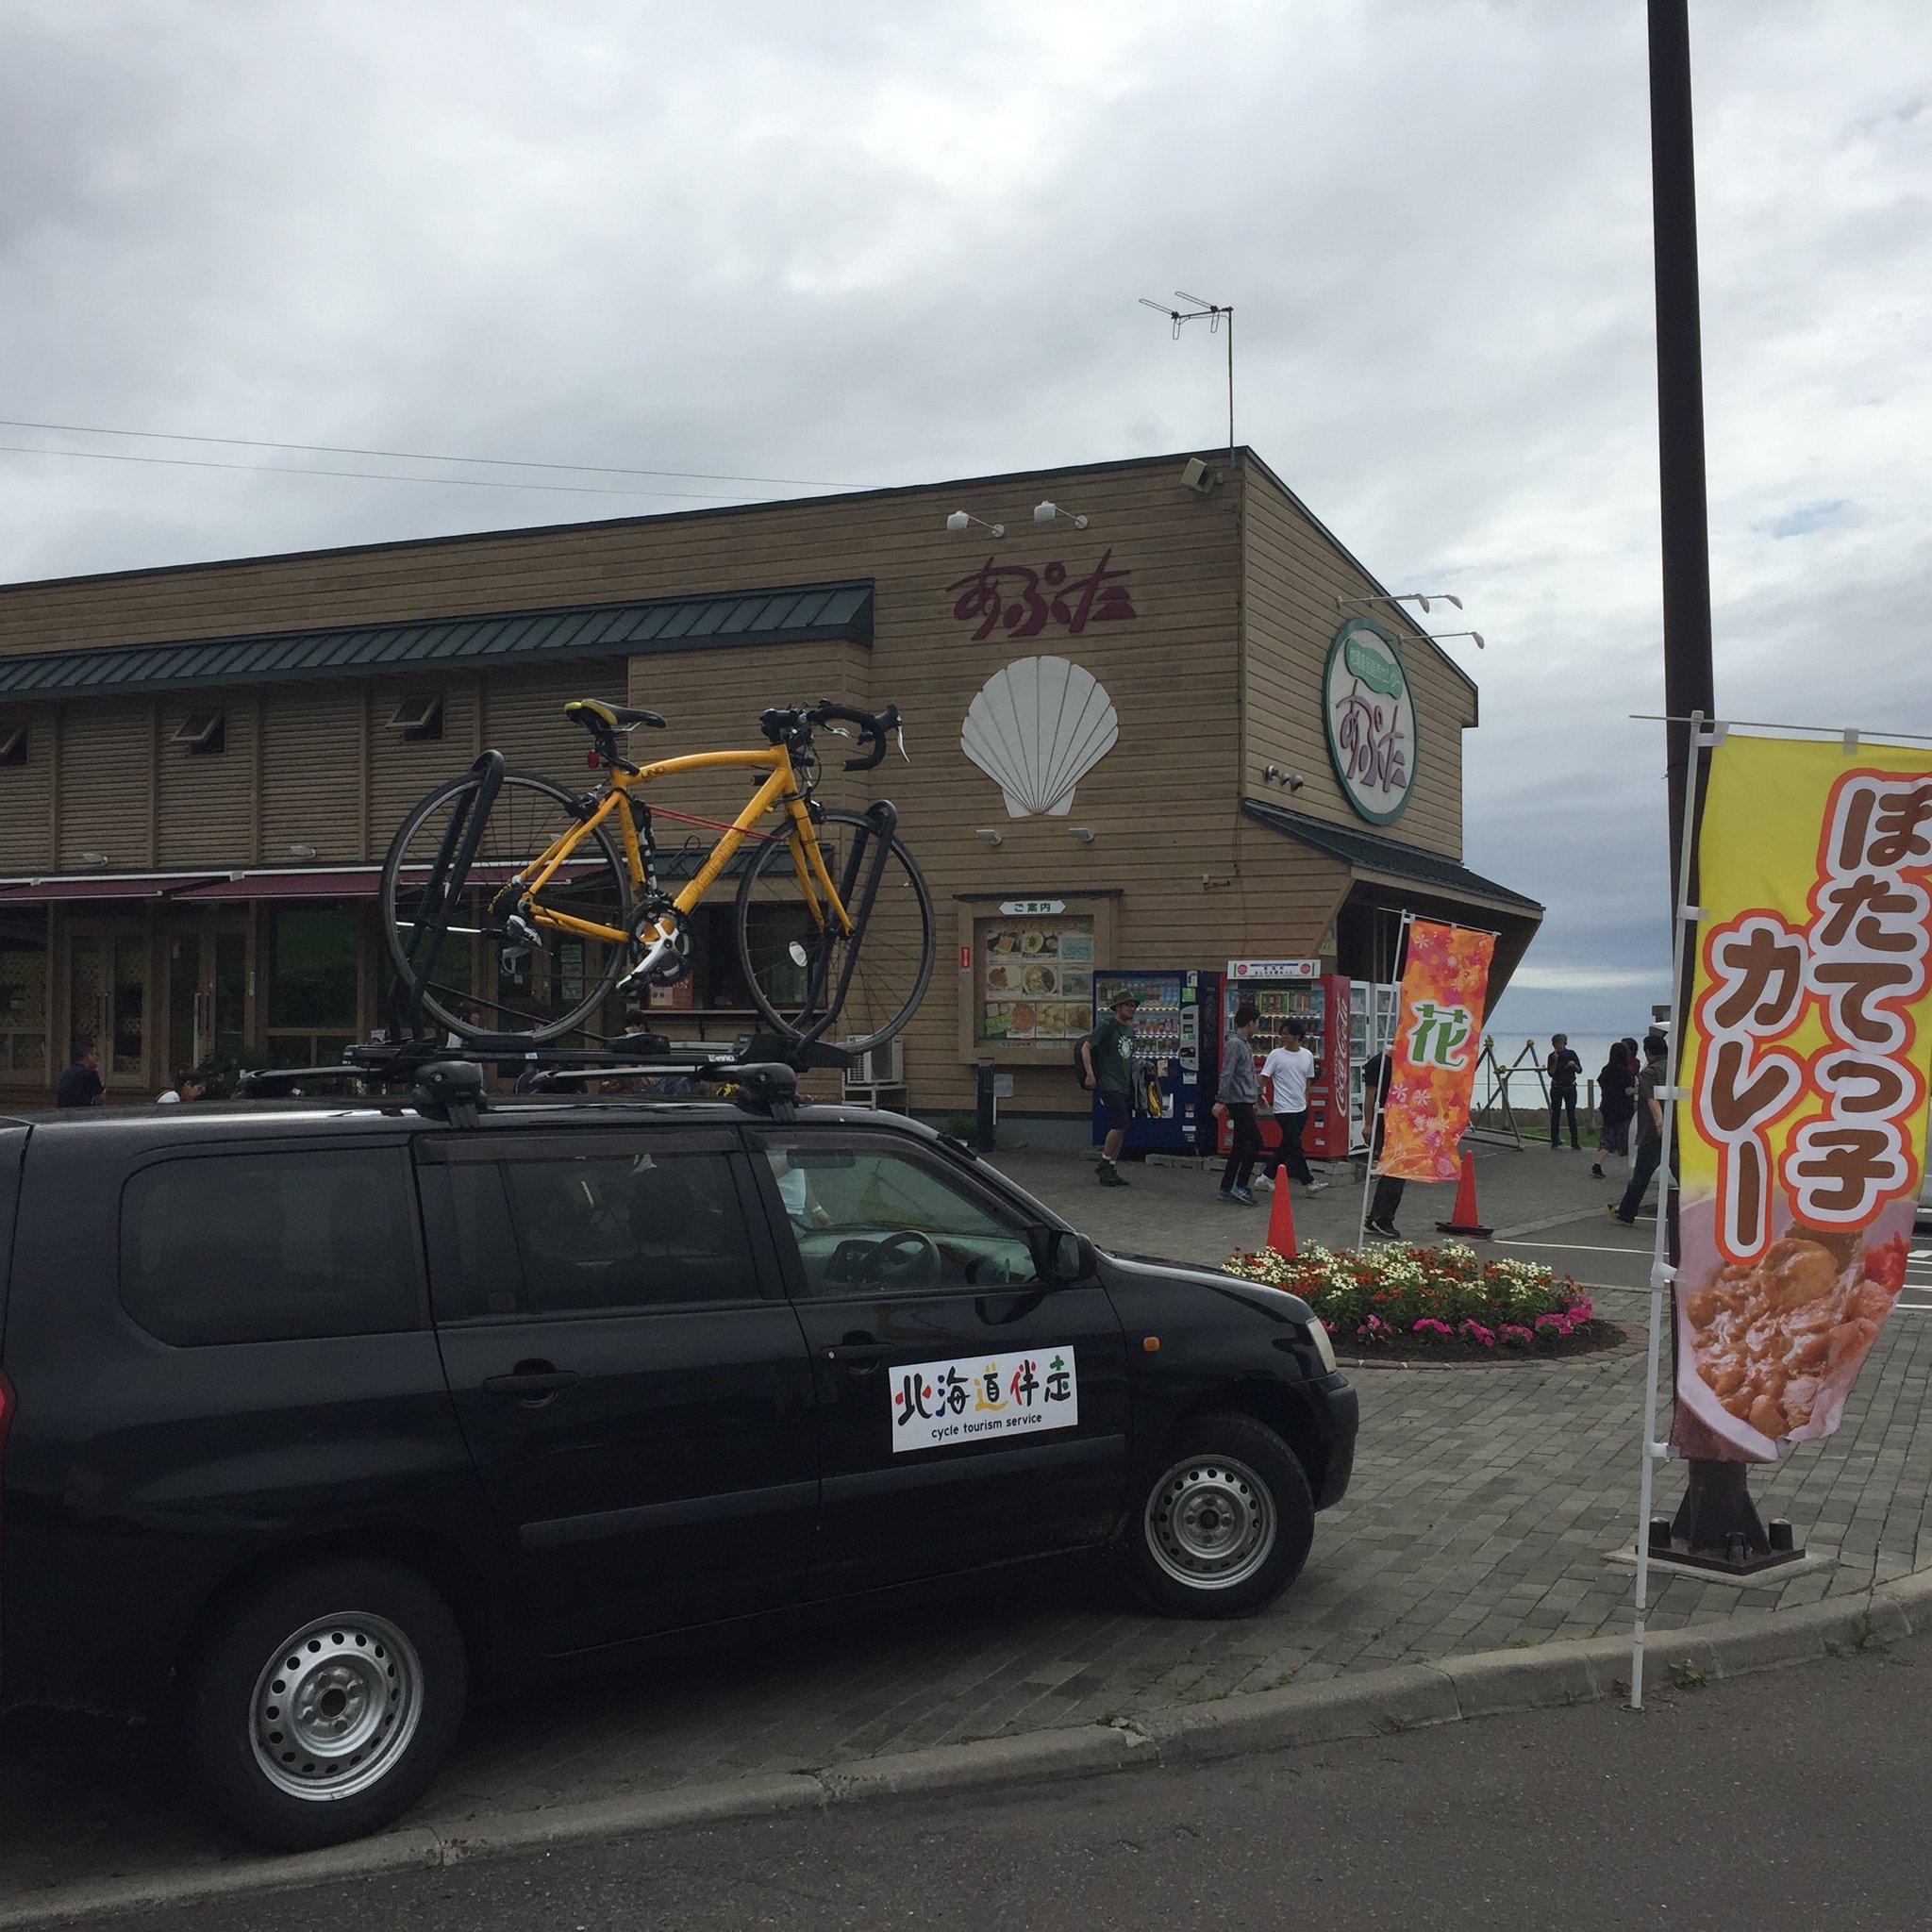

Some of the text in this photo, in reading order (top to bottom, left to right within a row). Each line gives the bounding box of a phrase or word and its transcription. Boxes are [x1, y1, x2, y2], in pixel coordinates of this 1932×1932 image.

[946, 548, 1137, 641] あぷた
[1336, 679, 1407, 792] あぷた
[1014, 901, 1051, 913] ご案内
[1411, 1003, 1469, 1068] 花
[1710, 926, 1802, 1247] カレー
[931, 1413, 1042, 1441] cycle tourism service
